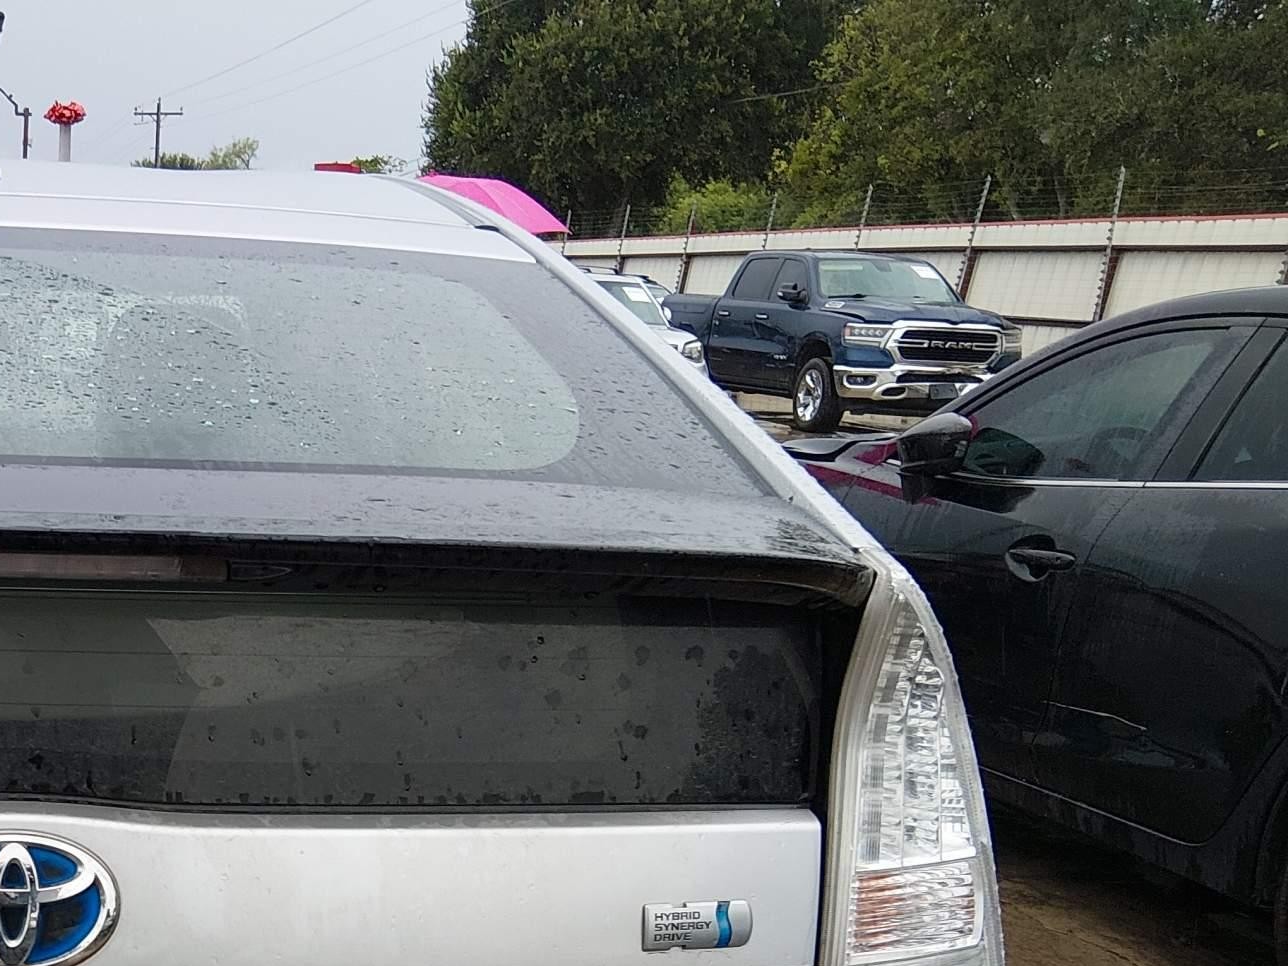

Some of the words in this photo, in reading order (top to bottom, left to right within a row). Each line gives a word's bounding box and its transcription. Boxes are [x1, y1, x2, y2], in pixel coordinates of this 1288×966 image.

[929, 340, 974, 350] RAM
[654, 911, 701, 921] HYBRID
[654, 920, 713, 932] SYNERGY
[653, 932, 693, 942] DRIVE
